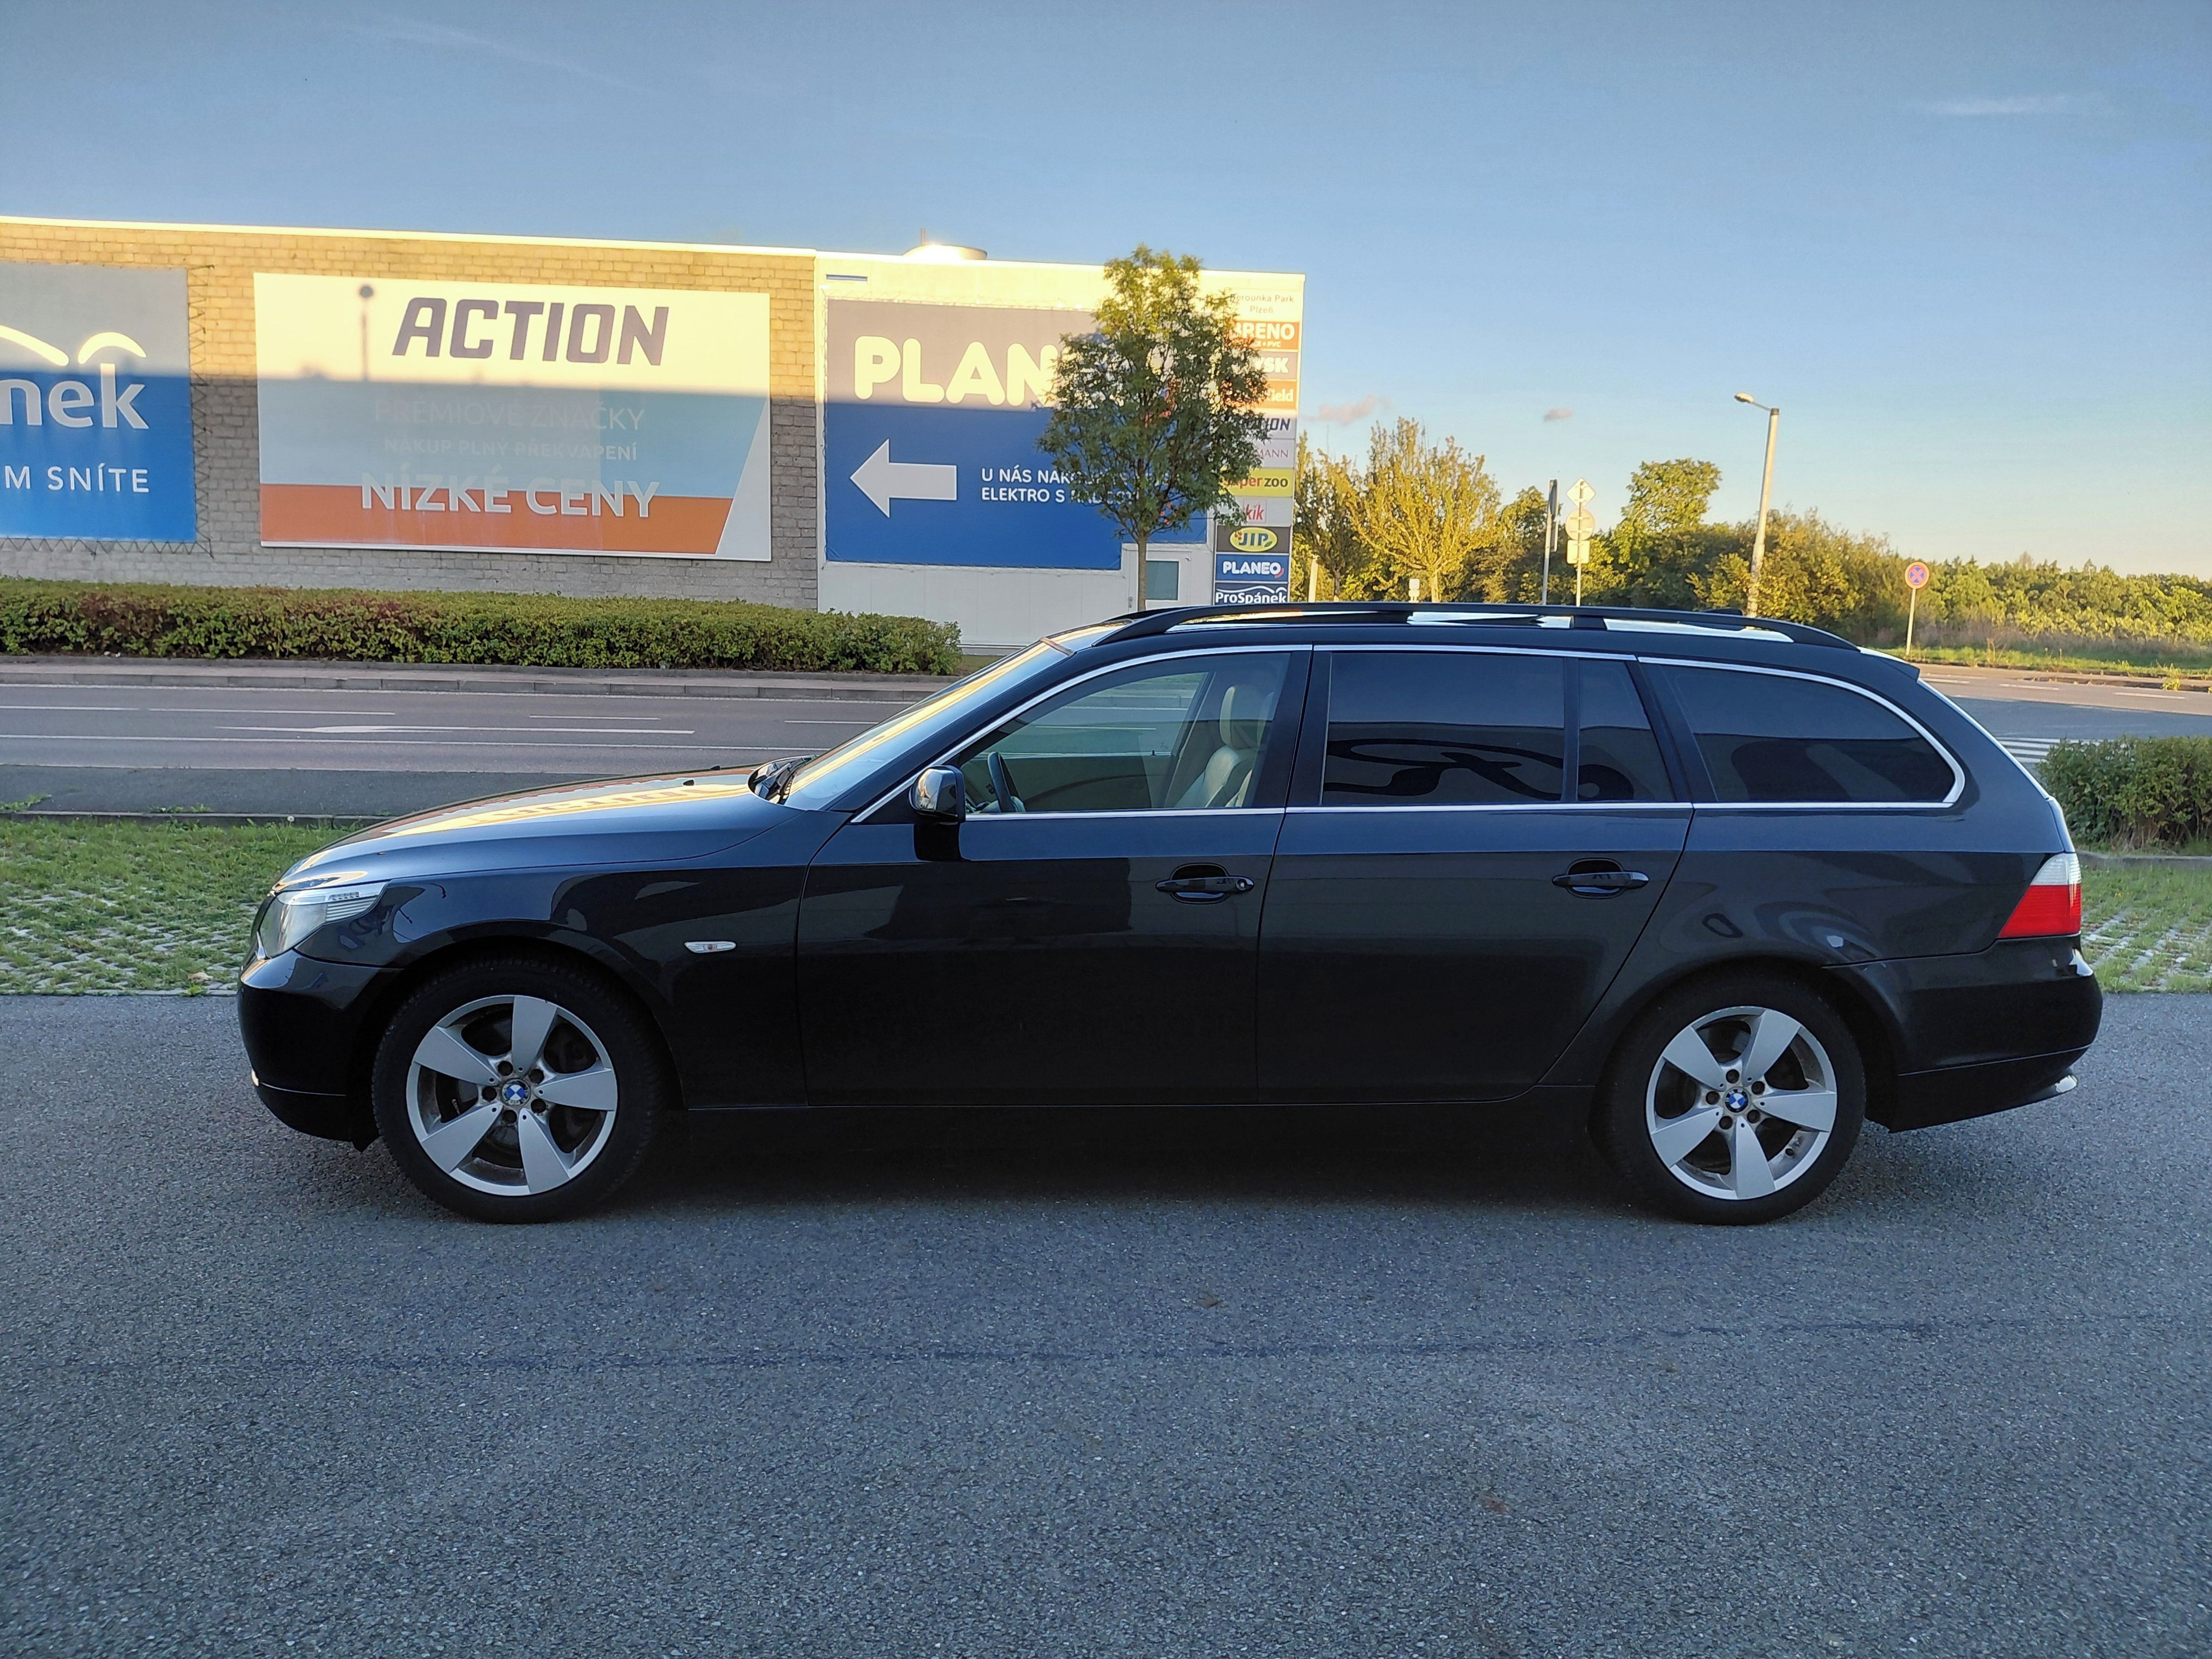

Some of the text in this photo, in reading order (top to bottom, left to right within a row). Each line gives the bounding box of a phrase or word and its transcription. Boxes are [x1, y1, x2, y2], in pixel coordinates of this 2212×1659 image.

[1275, 294, 1294, 303] Park
[392, 297, 670, 366] ACTION
[854, 335, 1139, 410] PLAN
[375, 398, 645, 430] PRÉMIOVÉ ZNAČKY
[384, 435, 638, 461] NÁKUP PLNÝ PŘEKVAPENÍ
[47, 462, 150, 493] SNÍTE
[981, 468, 993, 482] U
[999, 464, 1032, 484] NÁS
[361, 464, 662, 519] NÍZKÉ CENY
[981, 487, 1050, 503] ELEKTRO
[1054, 489, 1065, 503] S
[1239, 532, 1269, 546] JIP
[1223, 561, 1282, 575] PLANEO
[1215, 591, 1287, 604] ProSpánek
